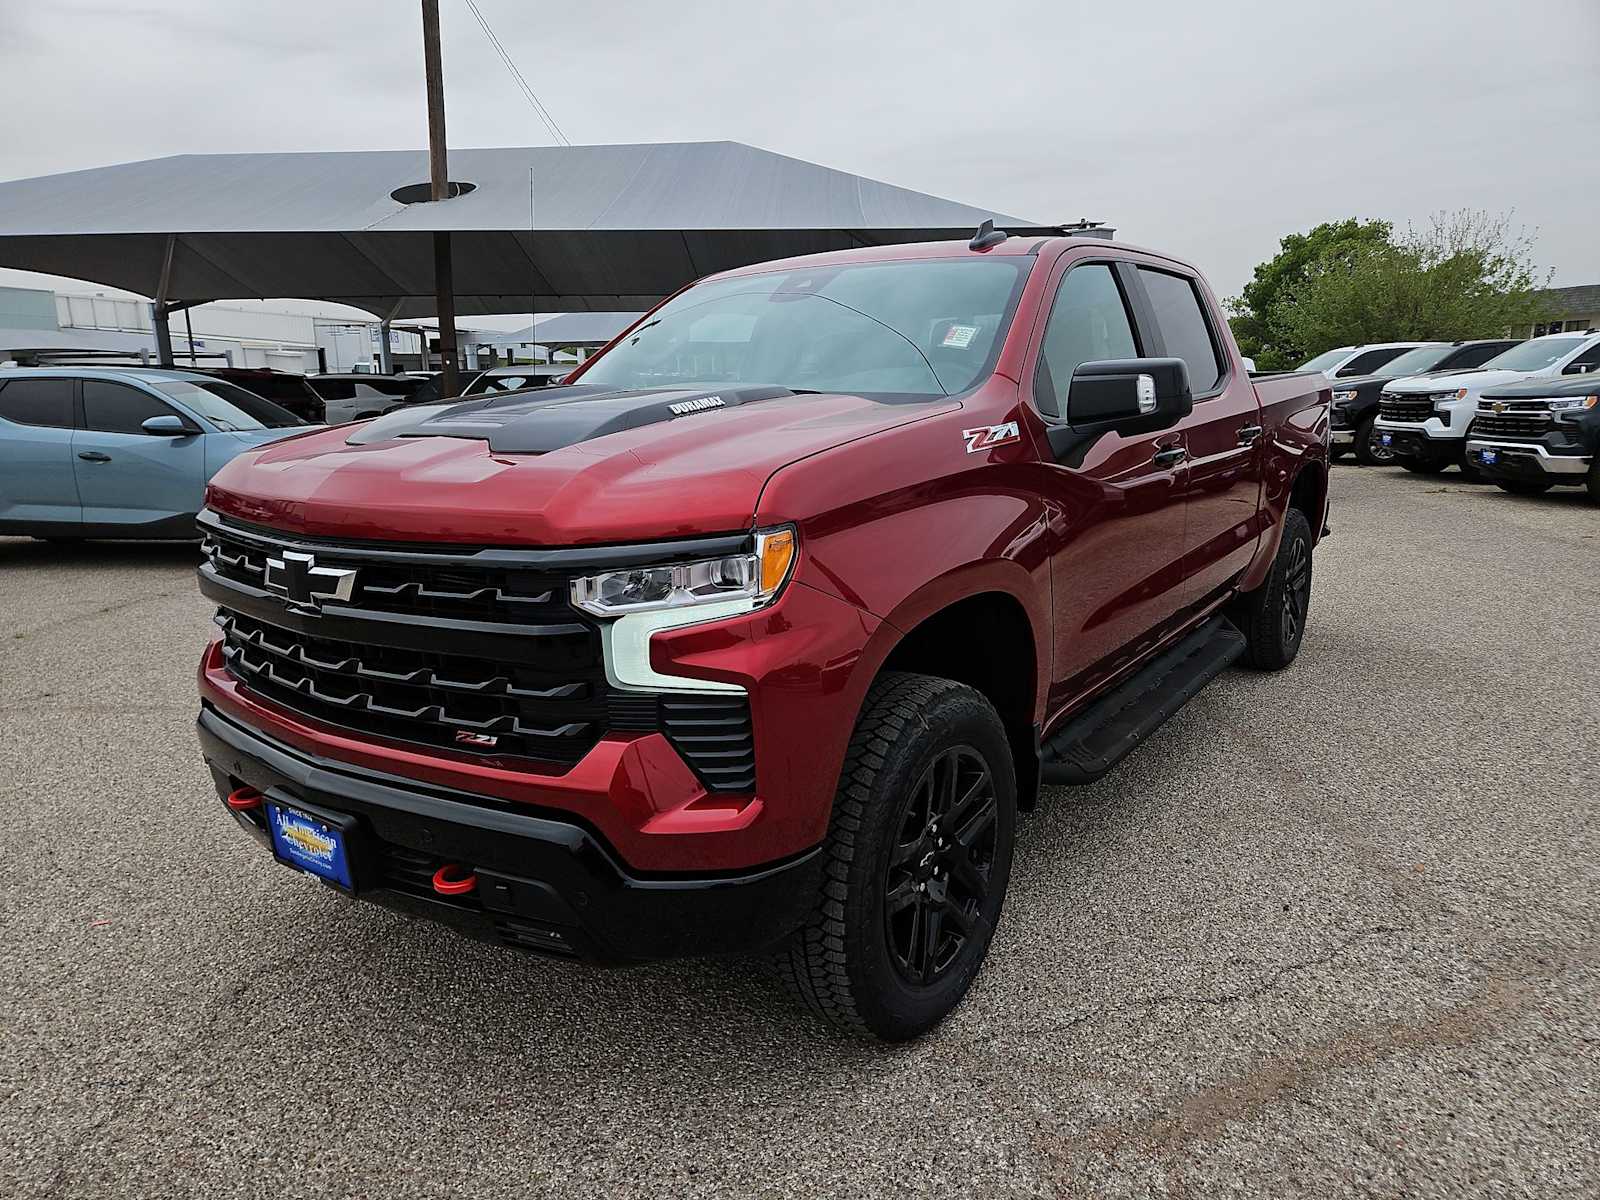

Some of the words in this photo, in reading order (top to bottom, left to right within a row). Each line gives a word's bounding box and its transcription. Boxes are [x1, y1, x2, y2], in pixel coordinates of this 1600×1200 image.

[669, 396, 726, 415] DURAMAX
[963, 421, 1020, 453] Z71
[456, 730, 498, 746] Z71
[276, 813, 290, 828] All
[292, 819, 337, 849] American
[286, 834, 335, 862] Chevrolet
